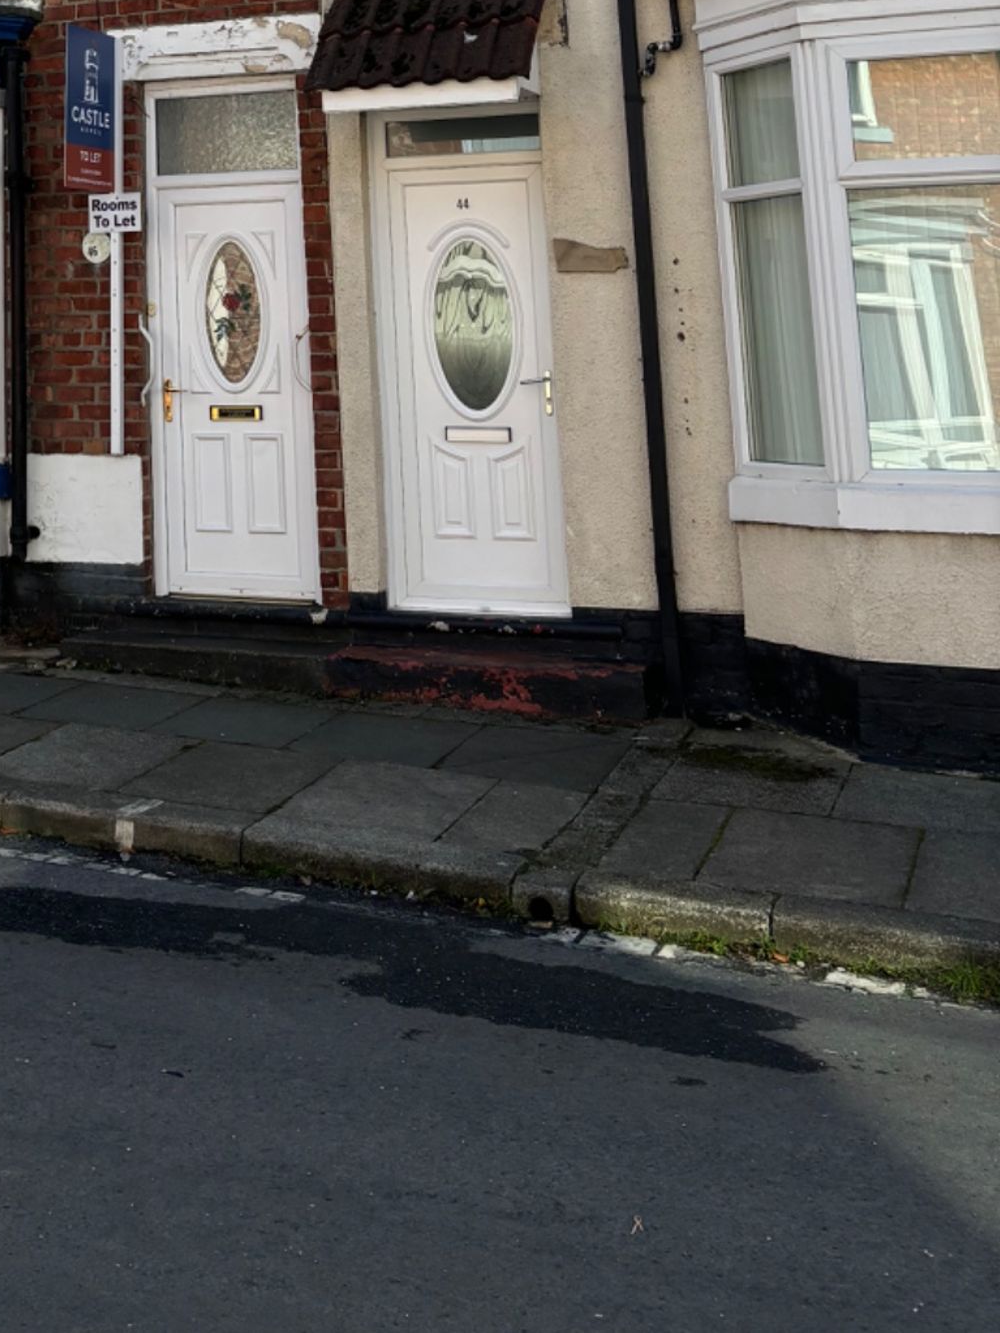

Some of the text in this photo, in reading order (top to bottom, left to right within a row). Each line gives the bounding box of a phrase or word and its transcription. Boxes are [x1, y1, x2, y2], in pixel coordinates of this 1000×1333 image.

[71, 105, 110, 130] CASTLE
[92, 198, 138, 212] Rooms
[456, 197, 470, 210] 44
[93, 214, 136, 228] To Let
